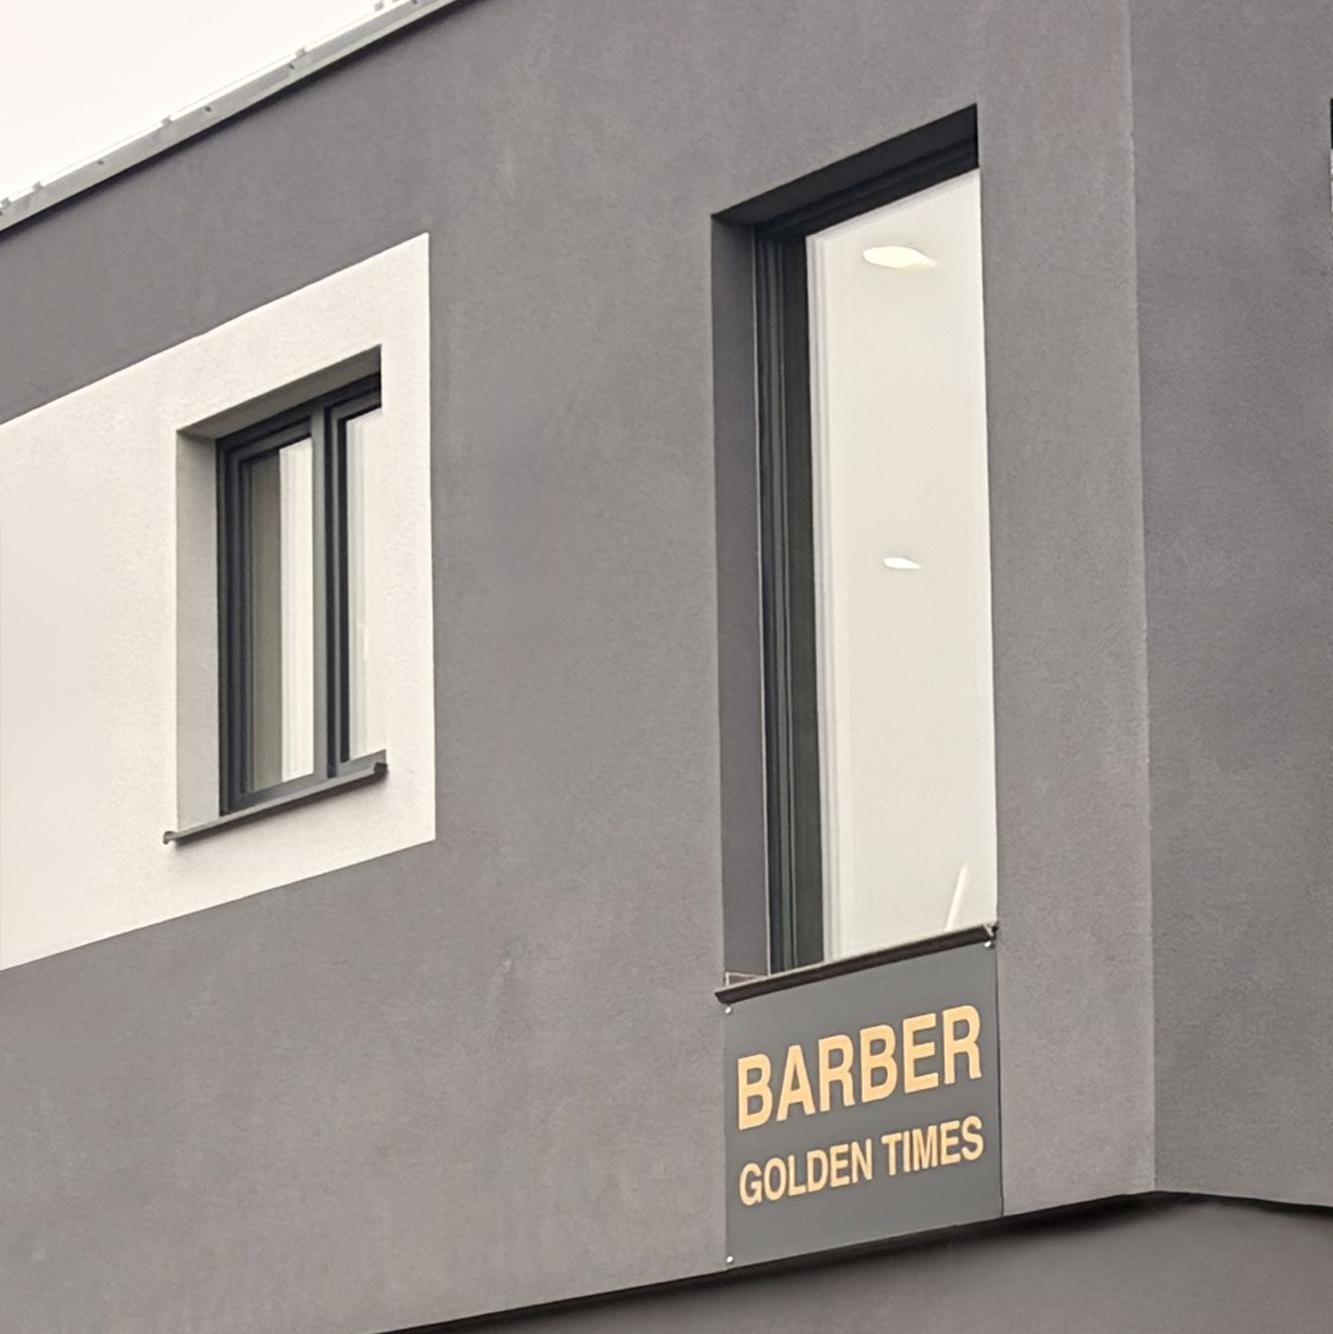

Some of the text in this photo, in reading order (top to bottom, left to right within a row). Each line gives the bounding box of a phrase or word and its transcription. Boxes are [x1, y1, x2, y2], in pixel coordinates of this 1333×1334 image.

[737, 1004, 982, 1131] BARBER
[739, 1115, 984, 1206] GOLDEN TIMES
